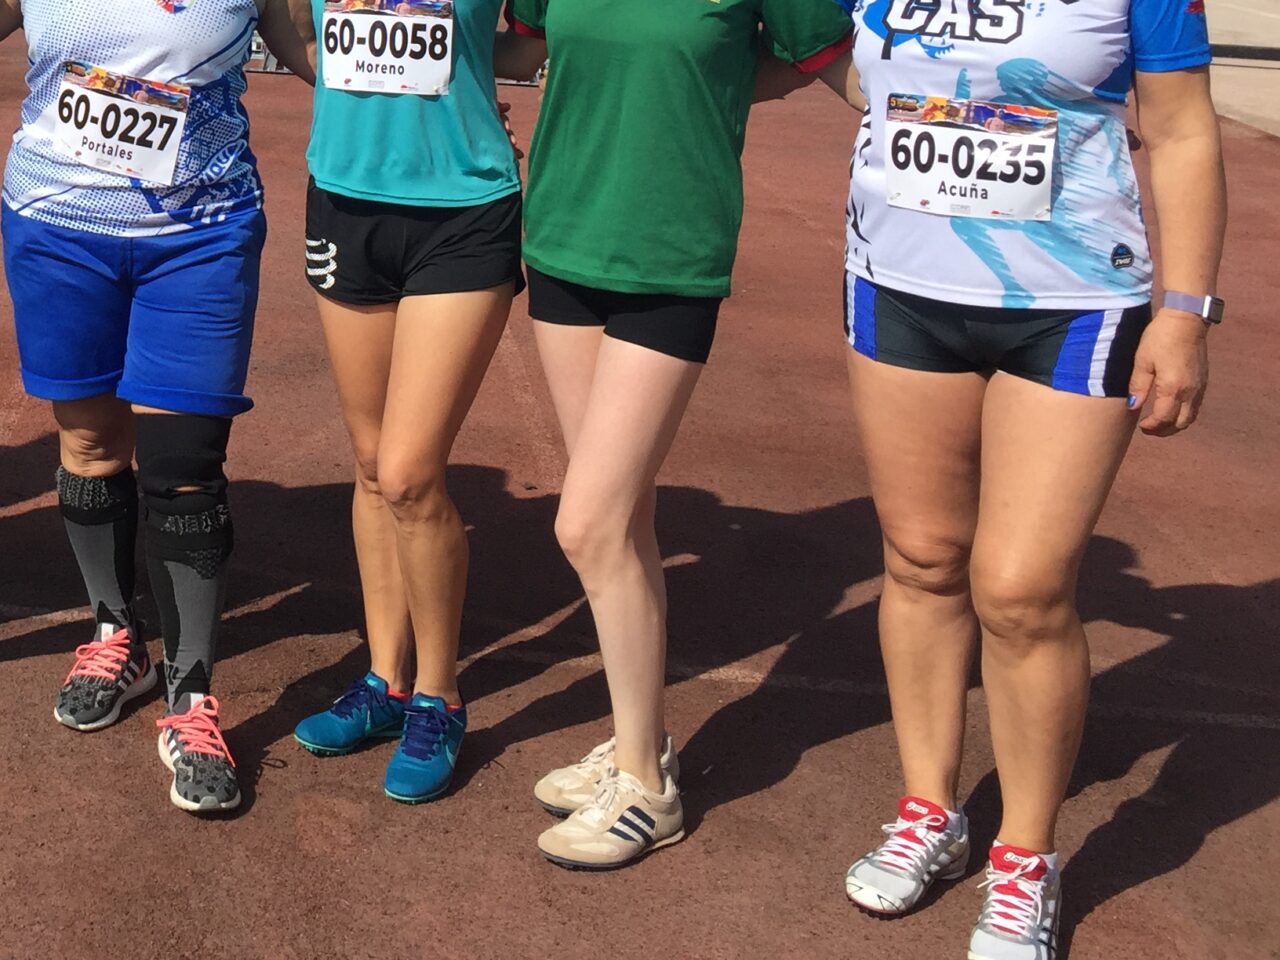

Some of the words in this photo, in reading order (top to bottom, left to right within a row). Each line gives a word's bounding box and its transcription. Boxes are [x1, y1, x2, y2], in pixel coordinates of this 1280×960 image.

[323, 17, 449, 61] 60-0058
[355, 59, 406, 76] Moreno
[57, 88, 179, 152] 60-0227
[80, 135, 134, 161] Portales
[890, 127, 1047, 186] 60-0235
[937, 180, 989, 201] Acuña
